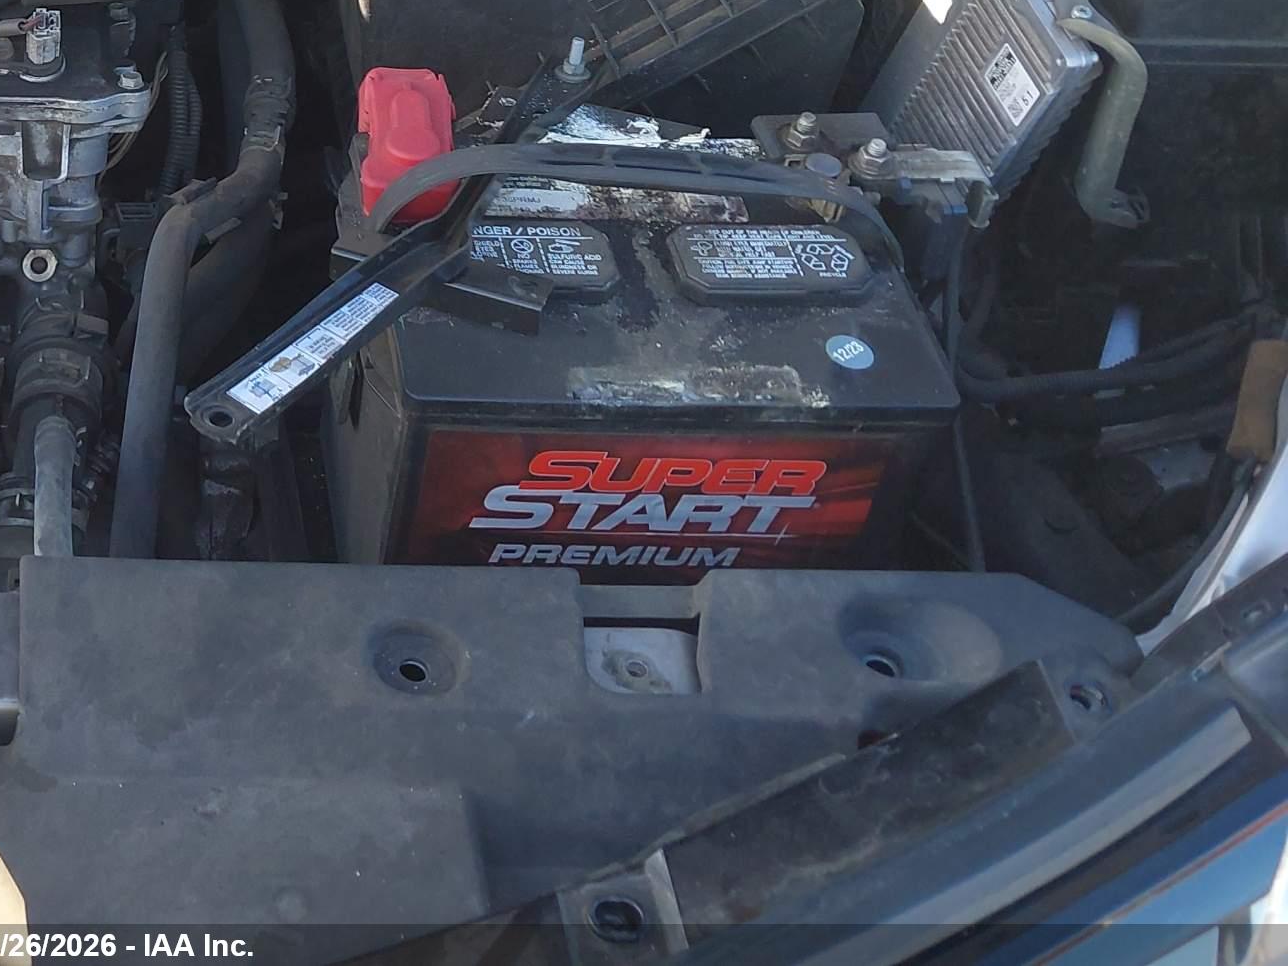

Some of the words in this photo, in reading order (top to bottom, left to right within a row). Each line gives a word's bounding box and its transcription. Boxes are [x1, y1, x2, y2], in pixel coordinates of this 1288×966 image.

[473, 226, 512, 235] NGER
[527, 227, 581, 236] POISON
[833, 341, 864, 362] 12/23
[519, 450, 827, 495] SUPER
[468, 485, 816, 533] START
[488, 543, 740, 567] PREMIUM
